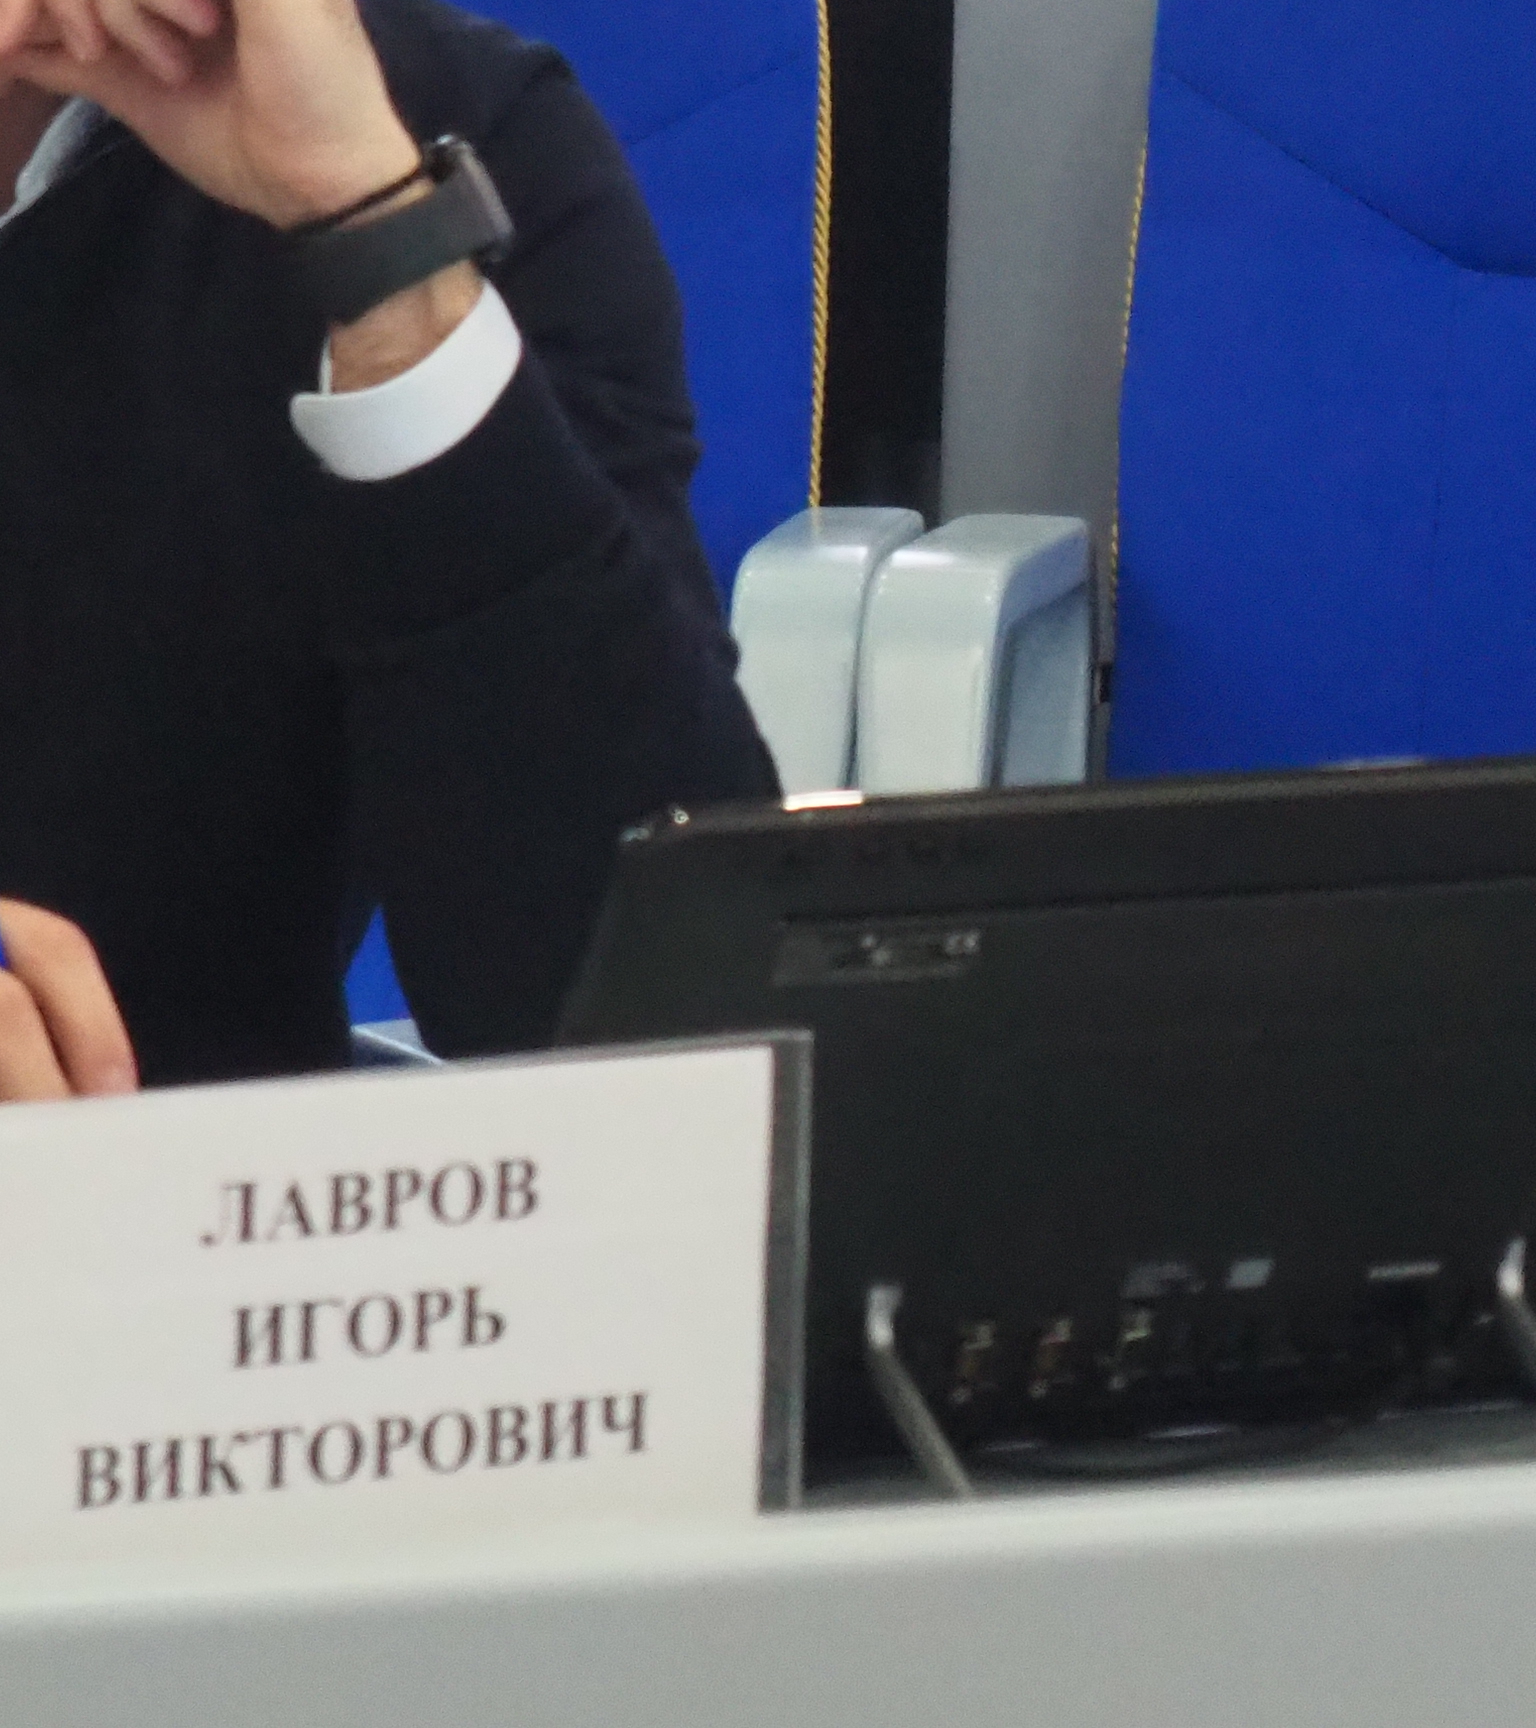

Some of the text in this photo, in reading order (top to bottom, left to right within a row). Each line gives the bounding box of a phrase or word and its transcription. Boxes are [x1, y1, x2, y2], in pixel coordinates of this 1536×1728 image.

[201, 1157, 541, 1247] ЛАВРОВ
[231, 1285, 507, 1369] ИГОРЬ
[75, 1391, 652, 1512] ВИКТОРОВИЧ
